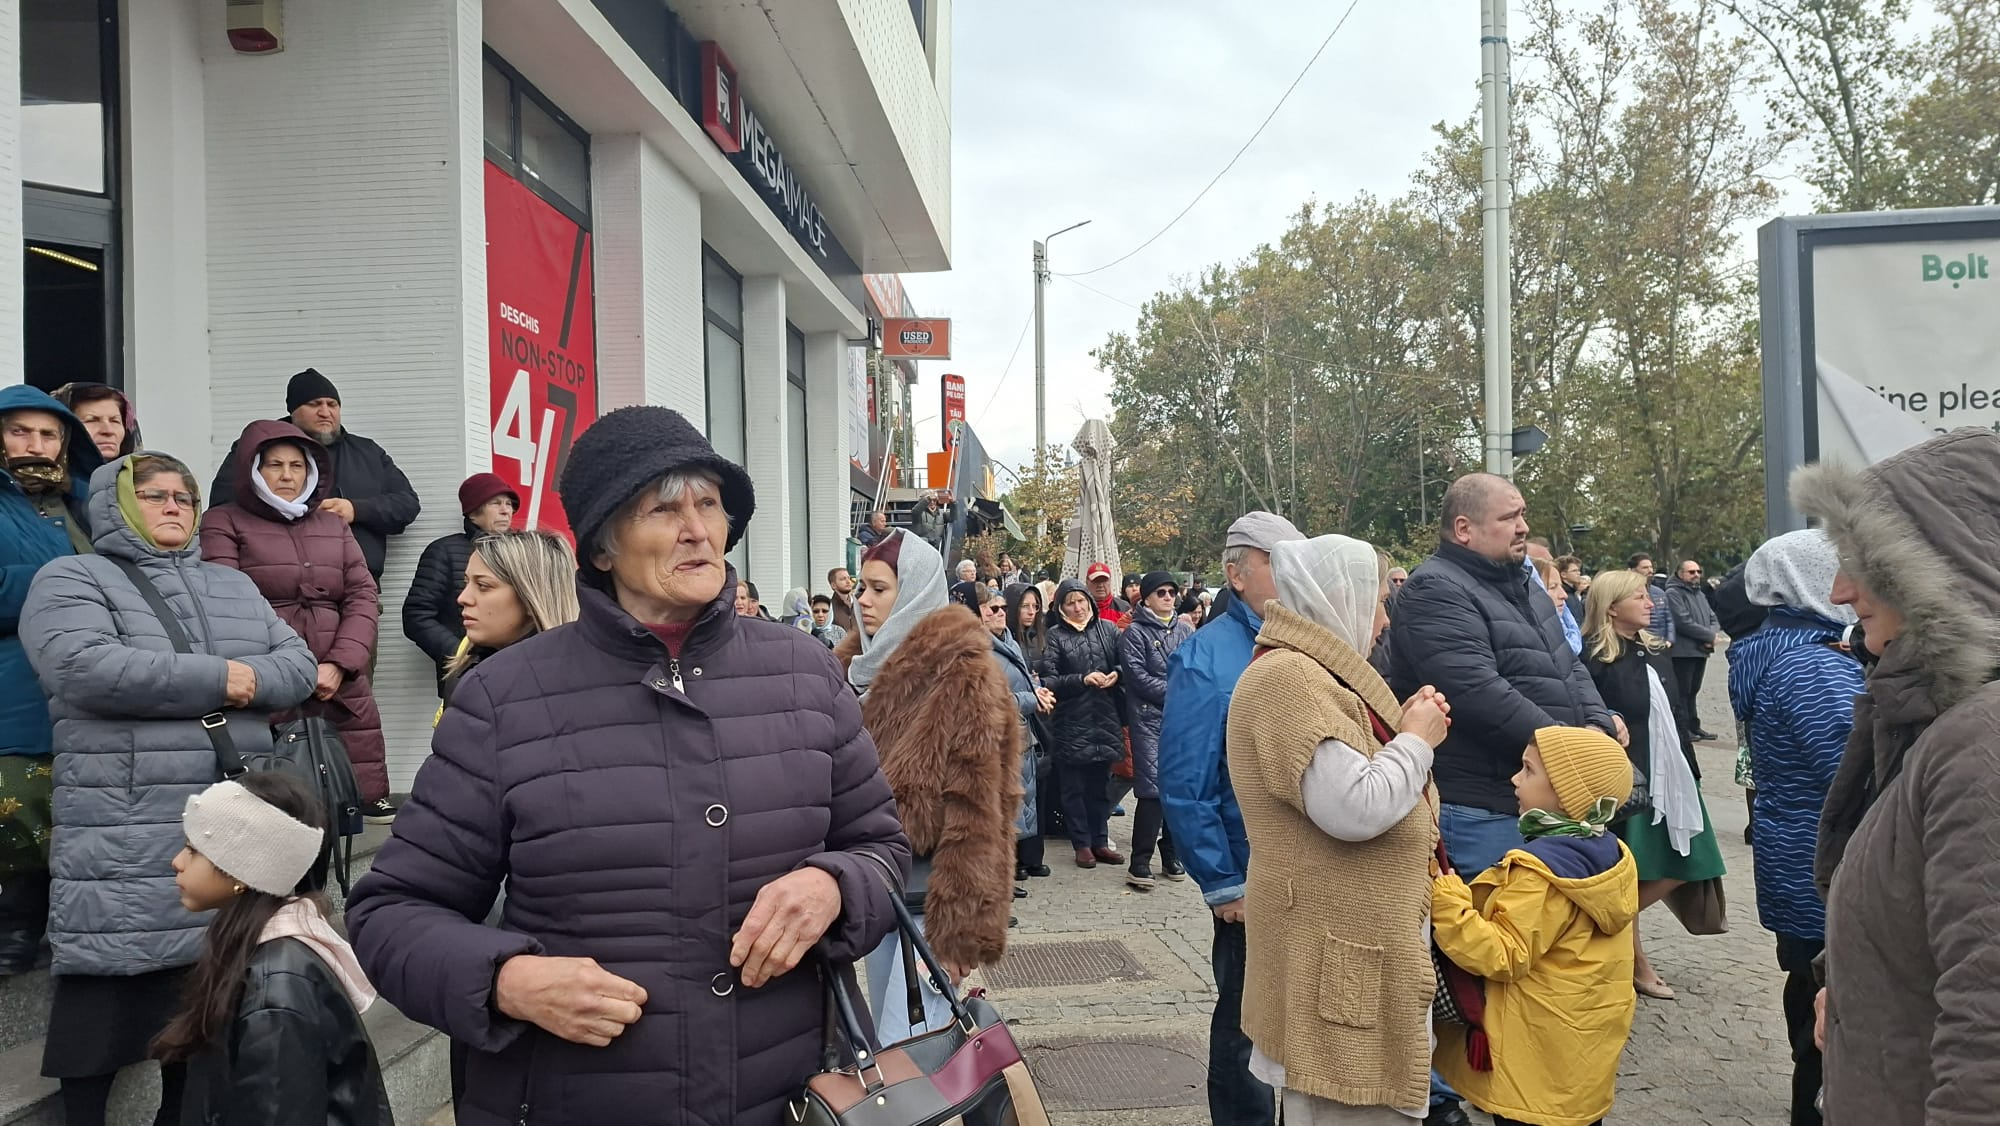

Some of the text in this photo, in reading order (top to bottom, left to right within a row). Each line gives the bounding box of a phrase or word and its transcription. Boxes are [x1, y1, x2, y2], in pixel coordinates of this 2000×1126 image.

[1921, 252, 1990, 289] Bolt
[500, 302, 540, 334] DESCHIS
[903, 331, 930, 340] USED
[501, 327, 586, 389] NON-STOP
[946, 381, 965, 392] BANI
